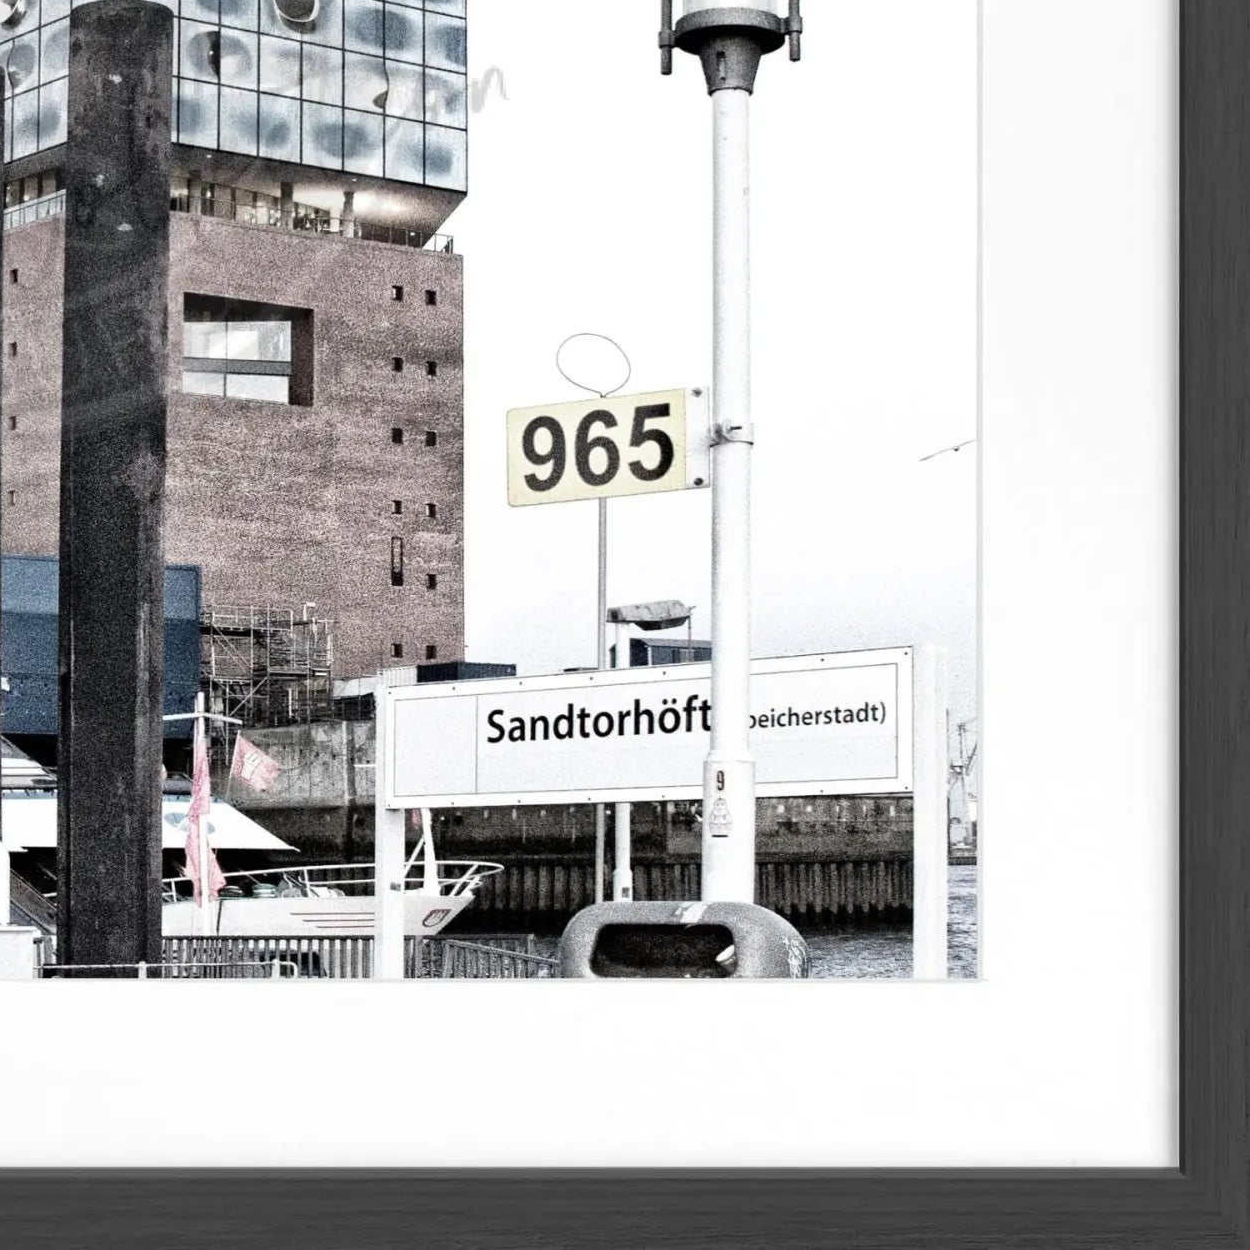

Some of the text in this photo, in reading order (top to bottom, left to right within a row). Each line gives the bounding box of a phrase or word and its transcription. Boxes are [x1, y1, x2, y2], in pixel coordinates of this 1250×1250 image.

[522, 402, 674, 492] 965
[486, 694, 712, 743] Sandtorhöft
[716, 770, 725, 791] 9
